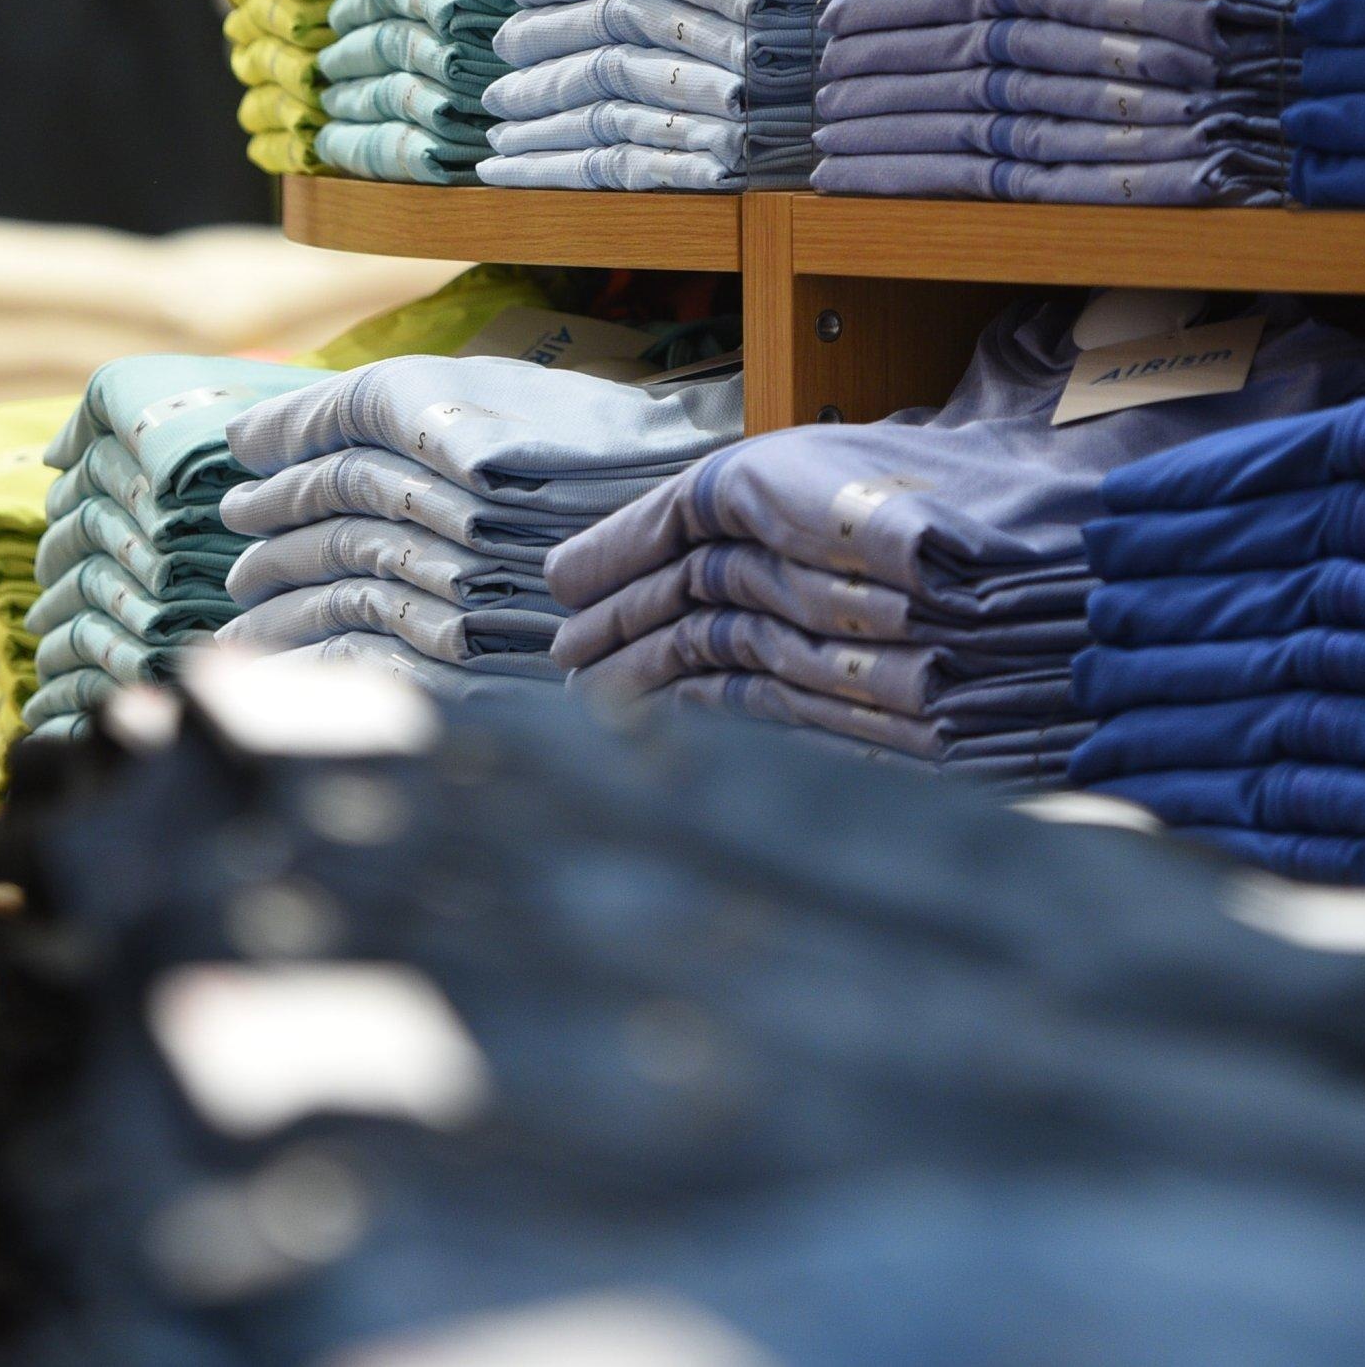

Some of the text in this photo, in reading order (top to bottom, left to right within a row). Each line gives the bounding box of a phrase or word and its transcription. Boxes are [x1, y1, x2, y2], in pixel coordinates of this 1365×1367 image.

[677, 22, 684, 40] S
[670, 68, 680, 84] S
[1119, 97, 1128, 116] S
[666, 113, 679, 127] S
[1123, 178, 1132, 198] S
[1091, 349, 1232, 385] AIRism
[418, 432, 425, 450] S
[405, 492, 412, 510] S
[400, 549, 411, 567] S
[399, 602, 410, 619] S
